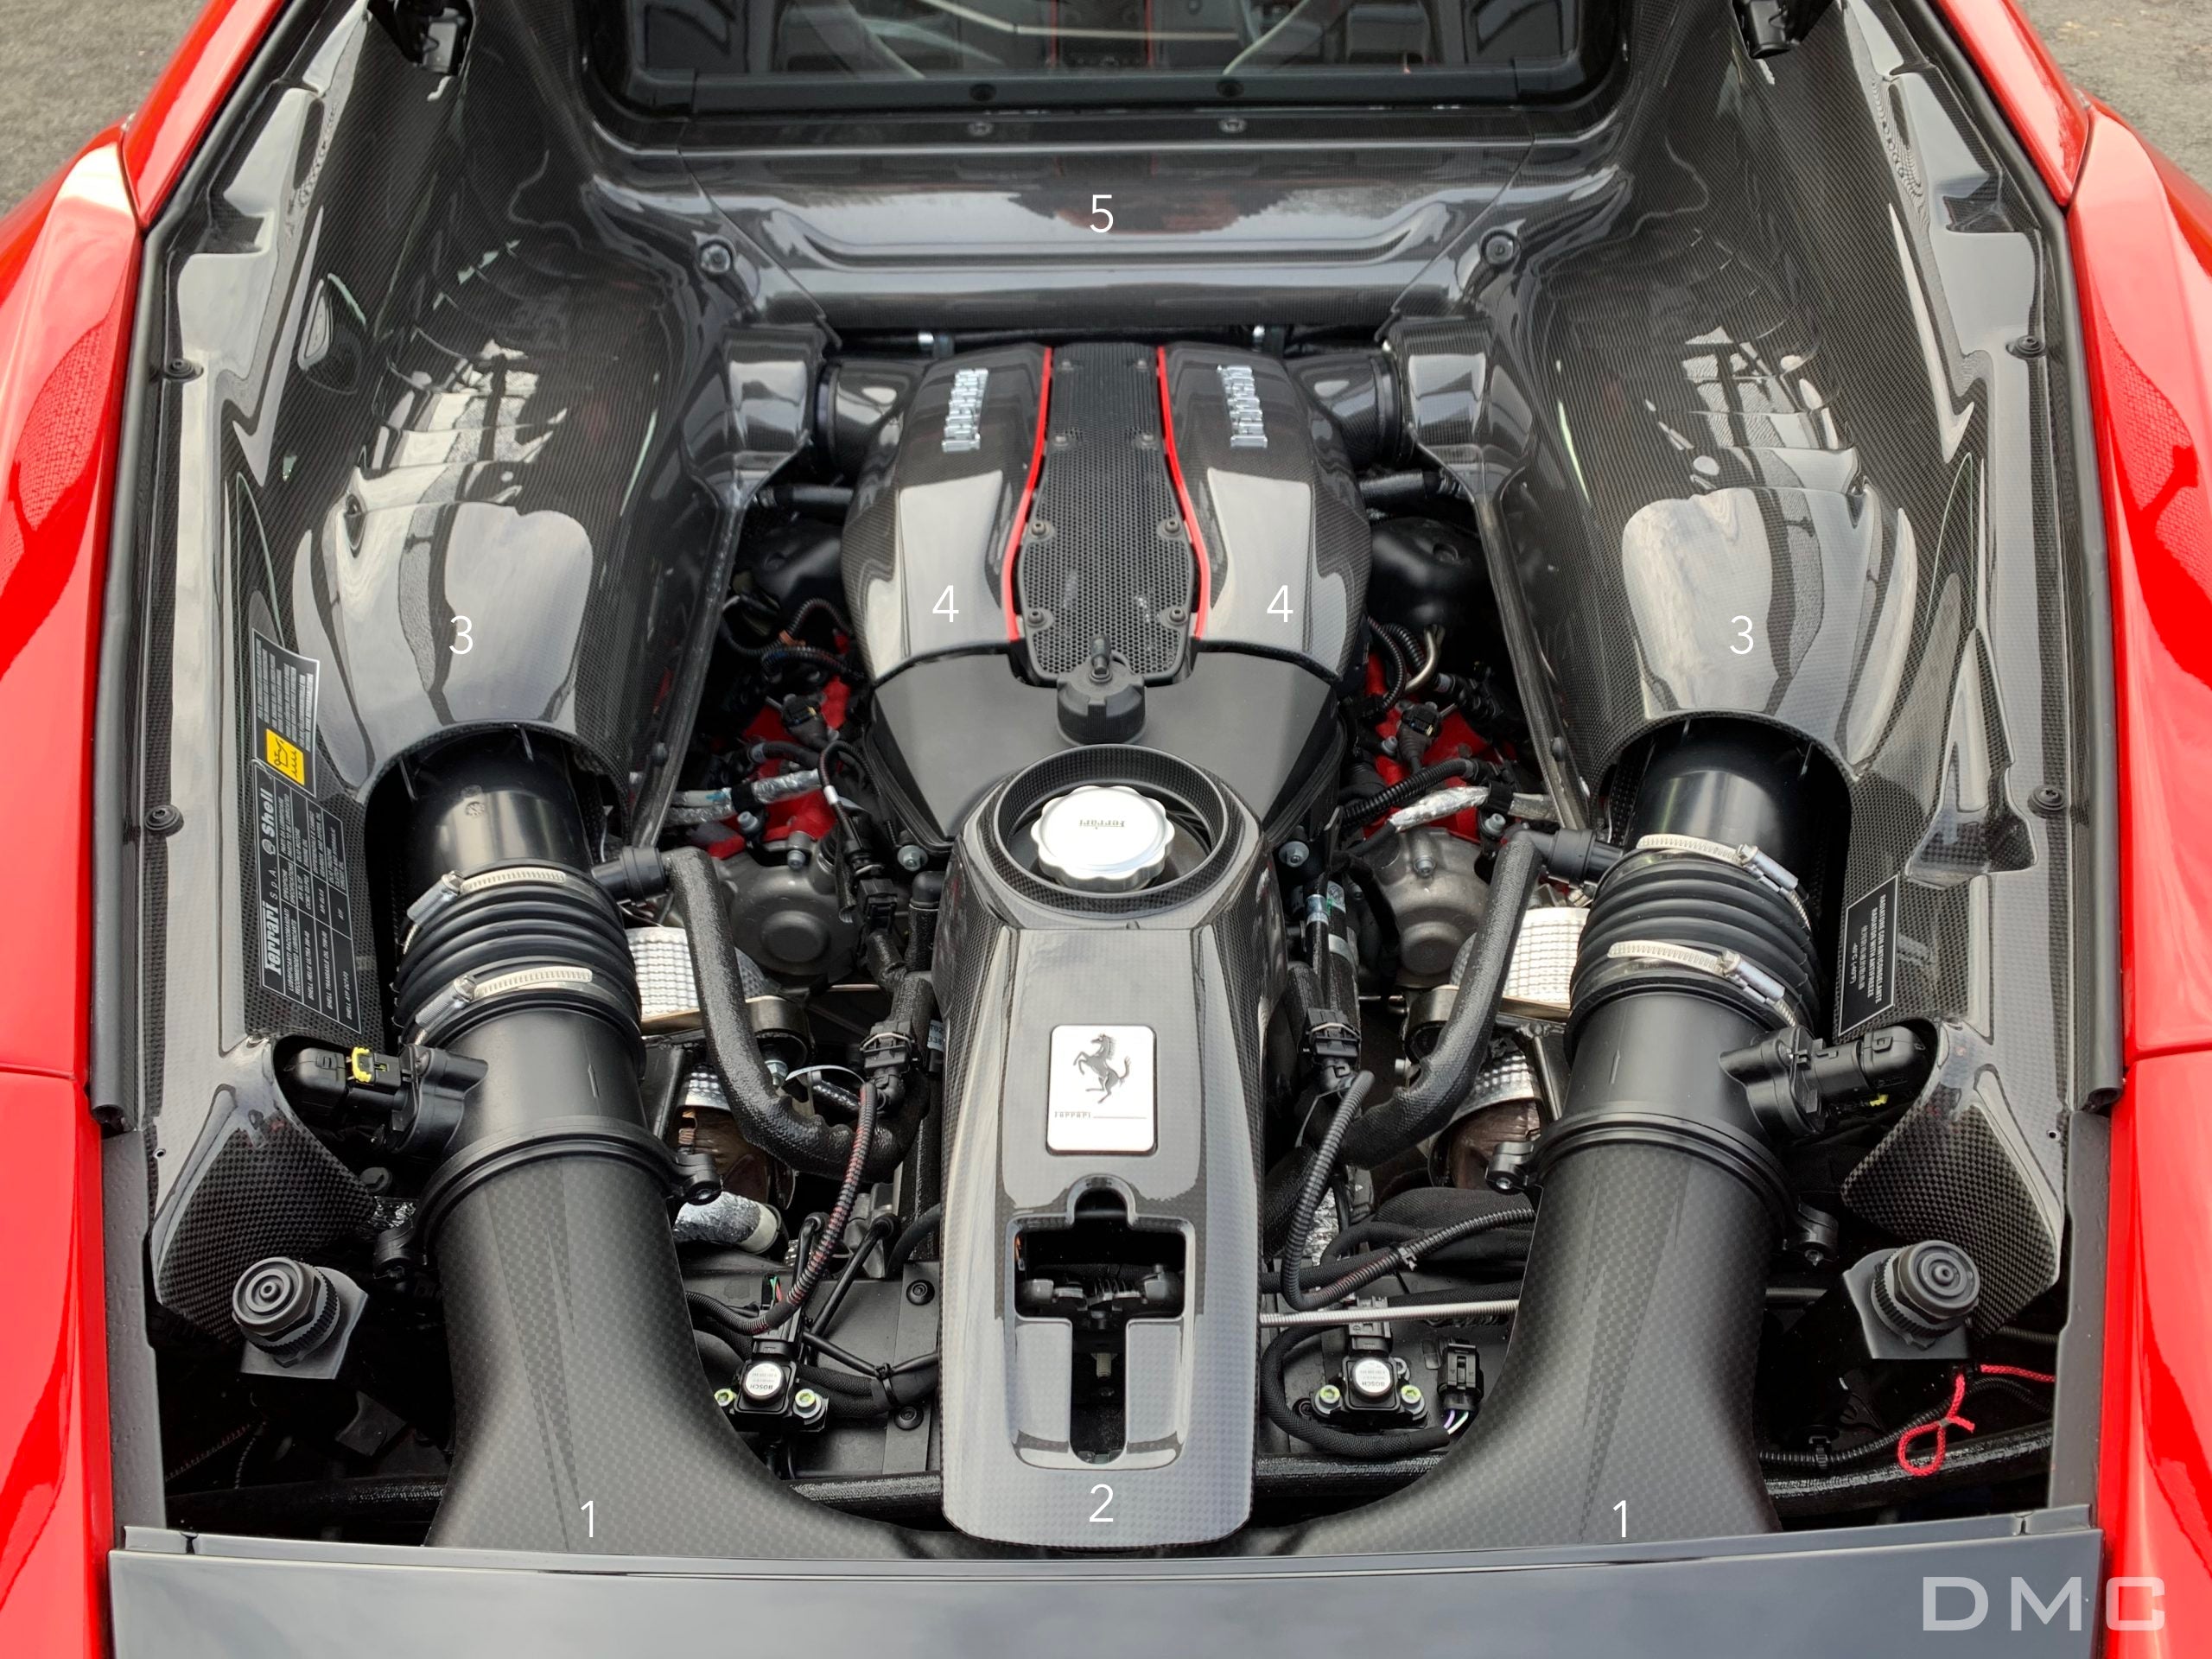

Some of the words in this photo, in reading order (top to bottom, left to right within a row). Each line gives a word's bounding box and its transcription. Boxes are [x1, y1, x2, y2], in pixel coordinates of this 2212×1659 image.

[260, 788, 275, 837] Shell
[263, 901, 281, 975] Ferrari
[1875, 945, 1884, 1003] ANTICONGELANTE
